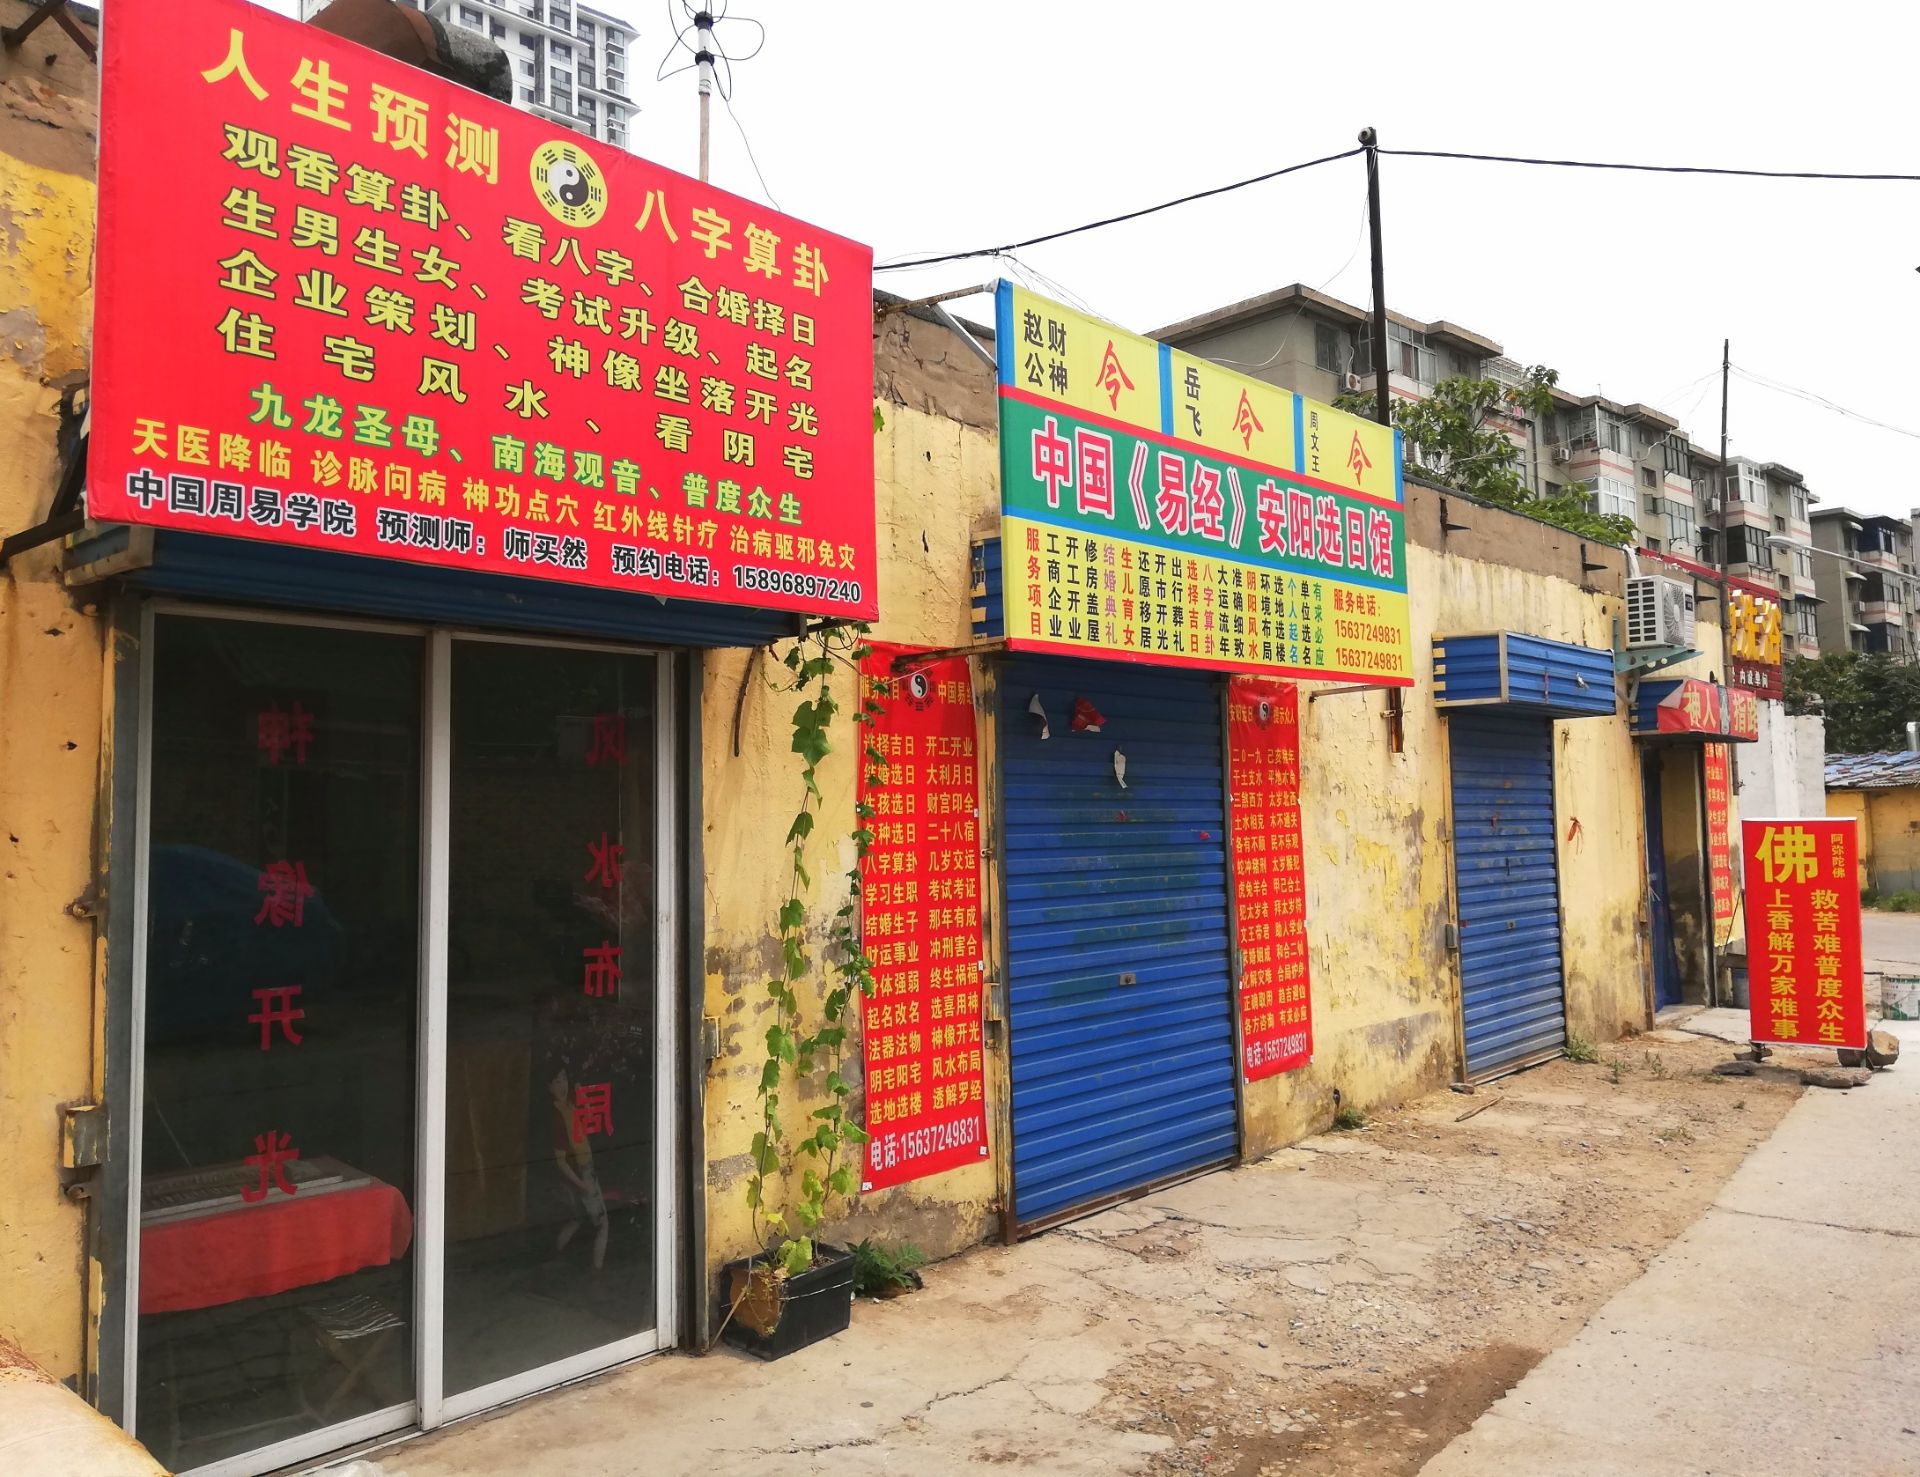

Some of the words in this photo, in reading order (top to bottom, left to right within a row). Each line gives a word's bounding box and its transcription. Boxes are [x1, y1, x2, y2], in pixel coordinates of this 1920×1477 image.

[201, 28, 499, 185] 人生预测
[634, 189, 829, 298] 八字算卦
[1095, 340, 1135, 412] 令
[1184, 367, 1203, 438] 岳飞
[1232, 388, 1264, 452] 令
[1309, 411, 1321, 474] 周文王
[1346, 430, 1372, 486] 令
[127, 469, 356, 537] 中国周易学院
[132, 418, 292, 480] 天医降临
[310, 450, 447, 507] 诊脉问病
[462, 477, 580, 527] 神功点穴
[594, 500, 719, 550] 红外线针疗
[730, 524, 856, 571] 治病驱邪免灾
[1031, 416, 1394, 579] 中国《易经》安阳选日馆
[1026, 527, 1042, 636] 服务项目
[1047, 533, 1062, 638] 工商企业
[1066, 536, 1081, 640] 开工开业
[1085, 538, 1100, 642] 修房盖屋
[1103, 543, 1117, 645] 结婚典礼
[1121, 547, 1135, 646] 生儿育女
[1138, 550, 1150, 648] 还愿移居
[1155, 553, 1168, 650] 开市开光
[1172, 556, 1184, 652] 出行葬礼
[1187, 559, 1199, 653] 选择吉日
[1203, 564, 1214, 655] 八字算卦
[1217, 566, 1229, 657] 大运流年
[1232, 568, 1244, 658] 准确细致
[1246, 571, 1258, 660] 阴阳风水
[1260, 573, 1272, 661] 环境布局
[1274, 575, 1286, 663] 选地选楼
[1288, 578, 1298, 664] 个人起名
[1301, 580, 1311, 665] 单位选名
[1313, 583, 1324, 666] 有求必应
[1335, 619, 1400, 645] 15637249831
[1336, 647, 1403, 671] 15637249831
[926, 736, 973, 757] 开工开业
[927, 763, 973, 786] 大利月日
[865, 852, 918, 875] 八字算卦
[928, 849, 975, 871] 几岁交运
[928, 820, 974, 842] 二十八宿
[1755, 826, 1818, 884] 佛
[1830, 833, 1846, 879] 阿弥陀佛
[866, 911, 918, 936] 结婚生子
[929, 905, 976, 930] 那年有成
[929, 878, 976, 902] 考试考证
[930, 934, 977, 960] 冲刑害合
[930, 962, 978, 990] 终生祸福
[1766, 888, 1799, 1040] 上香解万家难事
[1811, 888, 1846, 1043] 救苦难普度众生
[867, 1001, 920, 1030] 起名改名
[931, 991, 979, 1020] 选喜用神
[869, 1030, 921, 1062] 法器法物
[931, 1020, 980, 1049] 神像开光
[870, 1061, 922, 1092] 阴宅阳宅
[932, 1050, 981, 1079] 风水布局
[870, 1093, 922, 1126] 选地选楼
[932, 1080, 982, 1110] 透解罗经
